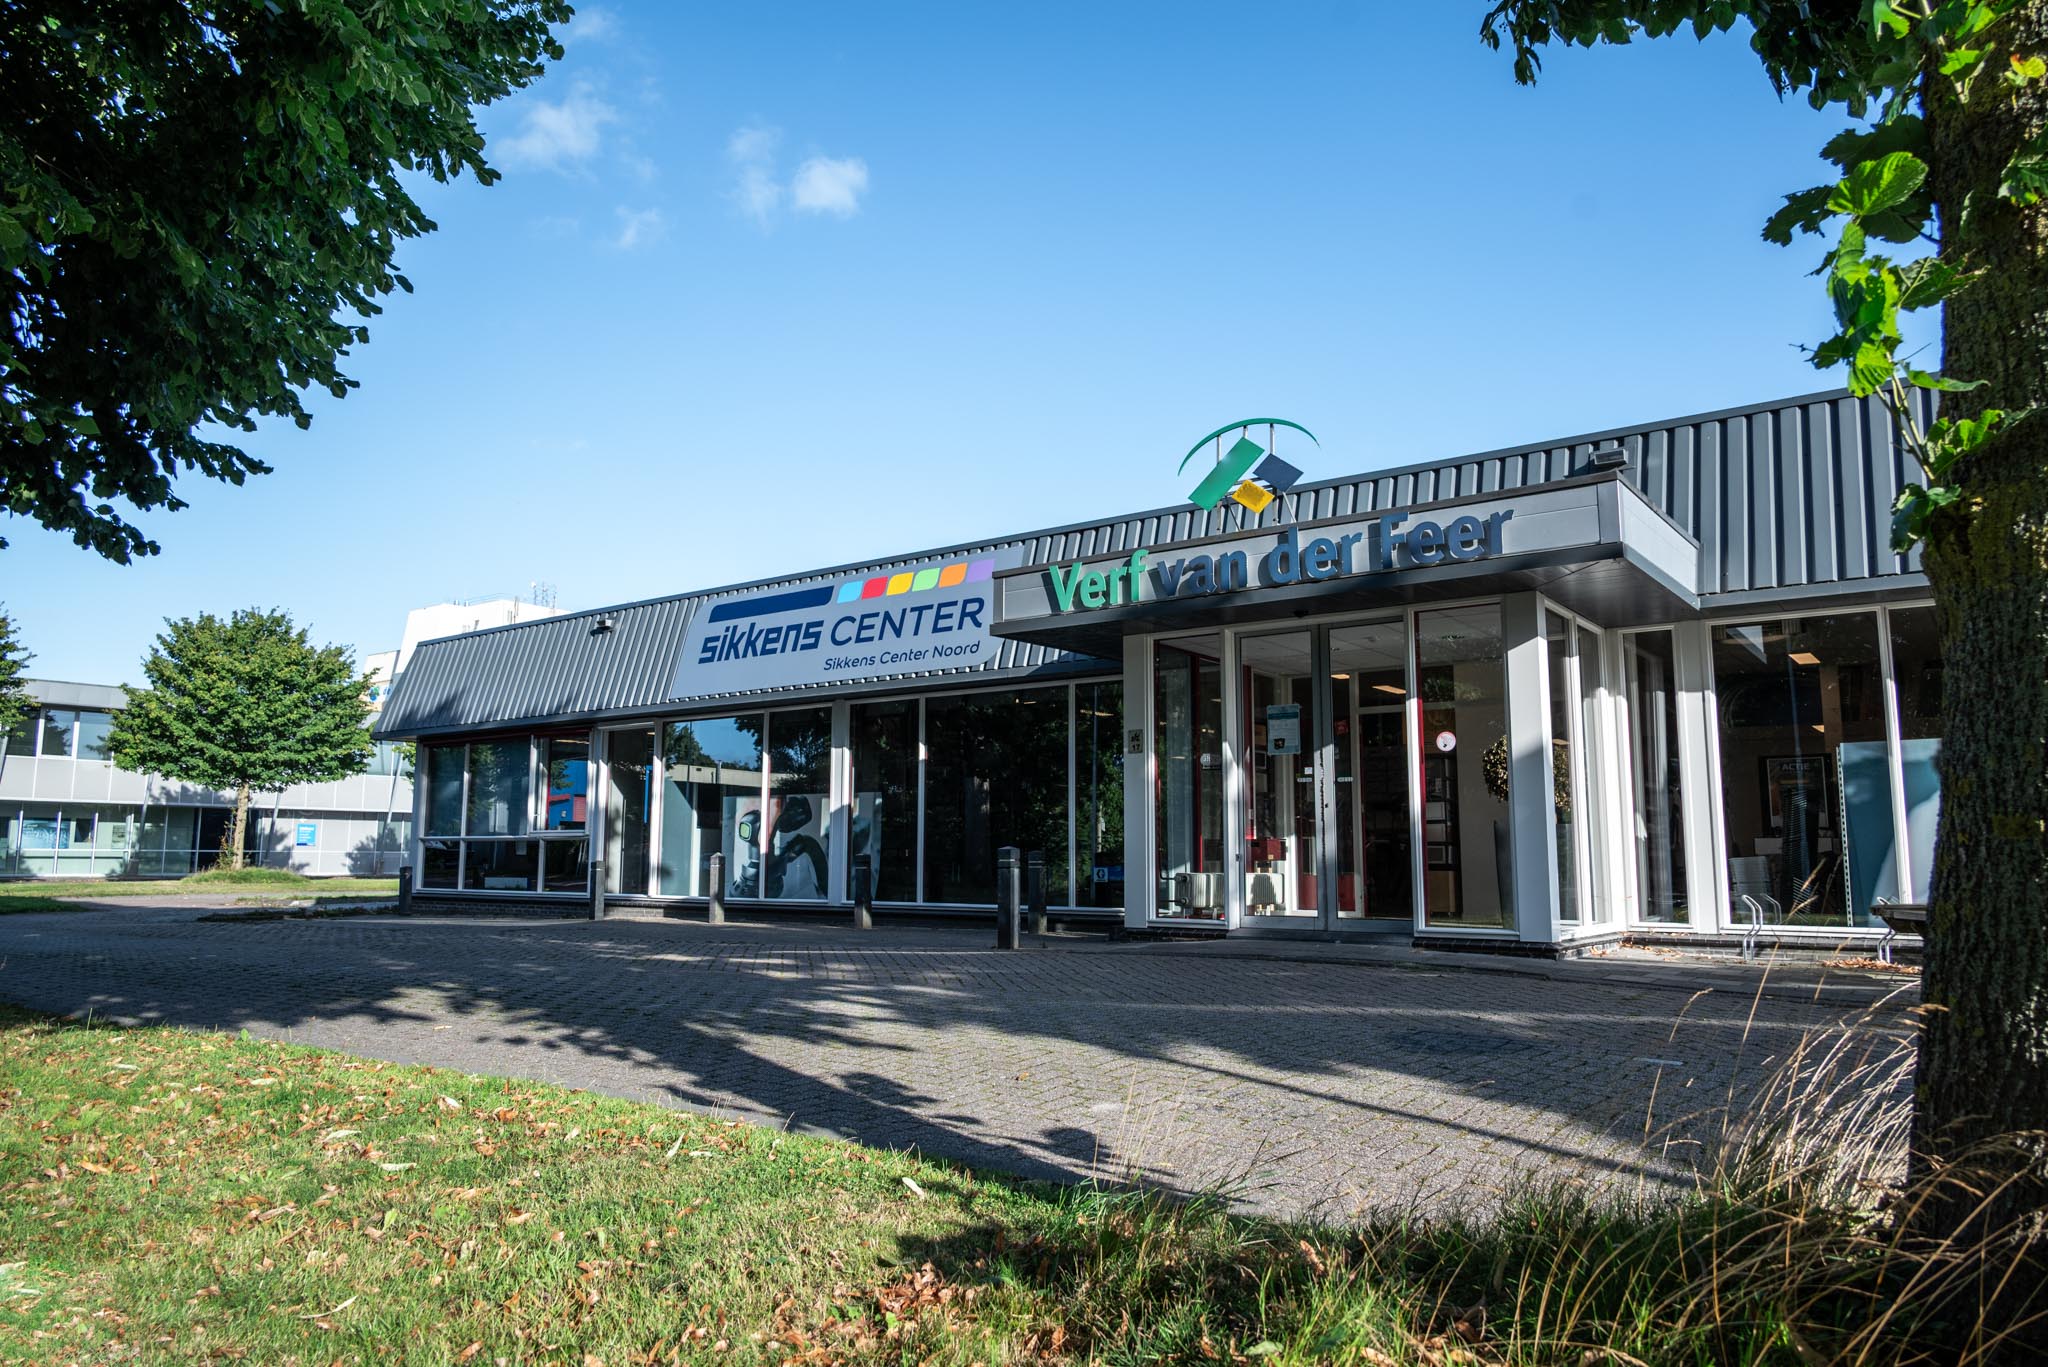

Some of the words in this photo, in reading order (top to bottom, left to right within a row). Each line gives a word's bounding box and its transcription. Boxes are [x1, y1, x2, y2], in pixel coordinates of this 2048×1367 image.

[1049, 549, 1149, 612] Verf
[1157, 550, 1248, 597] van
[1267, 526, 1363, 584] der
[1379, 509, 1514, 569] Feer
[698, 620, 824, 664] sikkens
[830, 597, 985, 646] CENTER
[823, 655, 876, 671] Sikkens
[879, 650, 929, 664] Center
[932, 640, 981, 658] Noord
